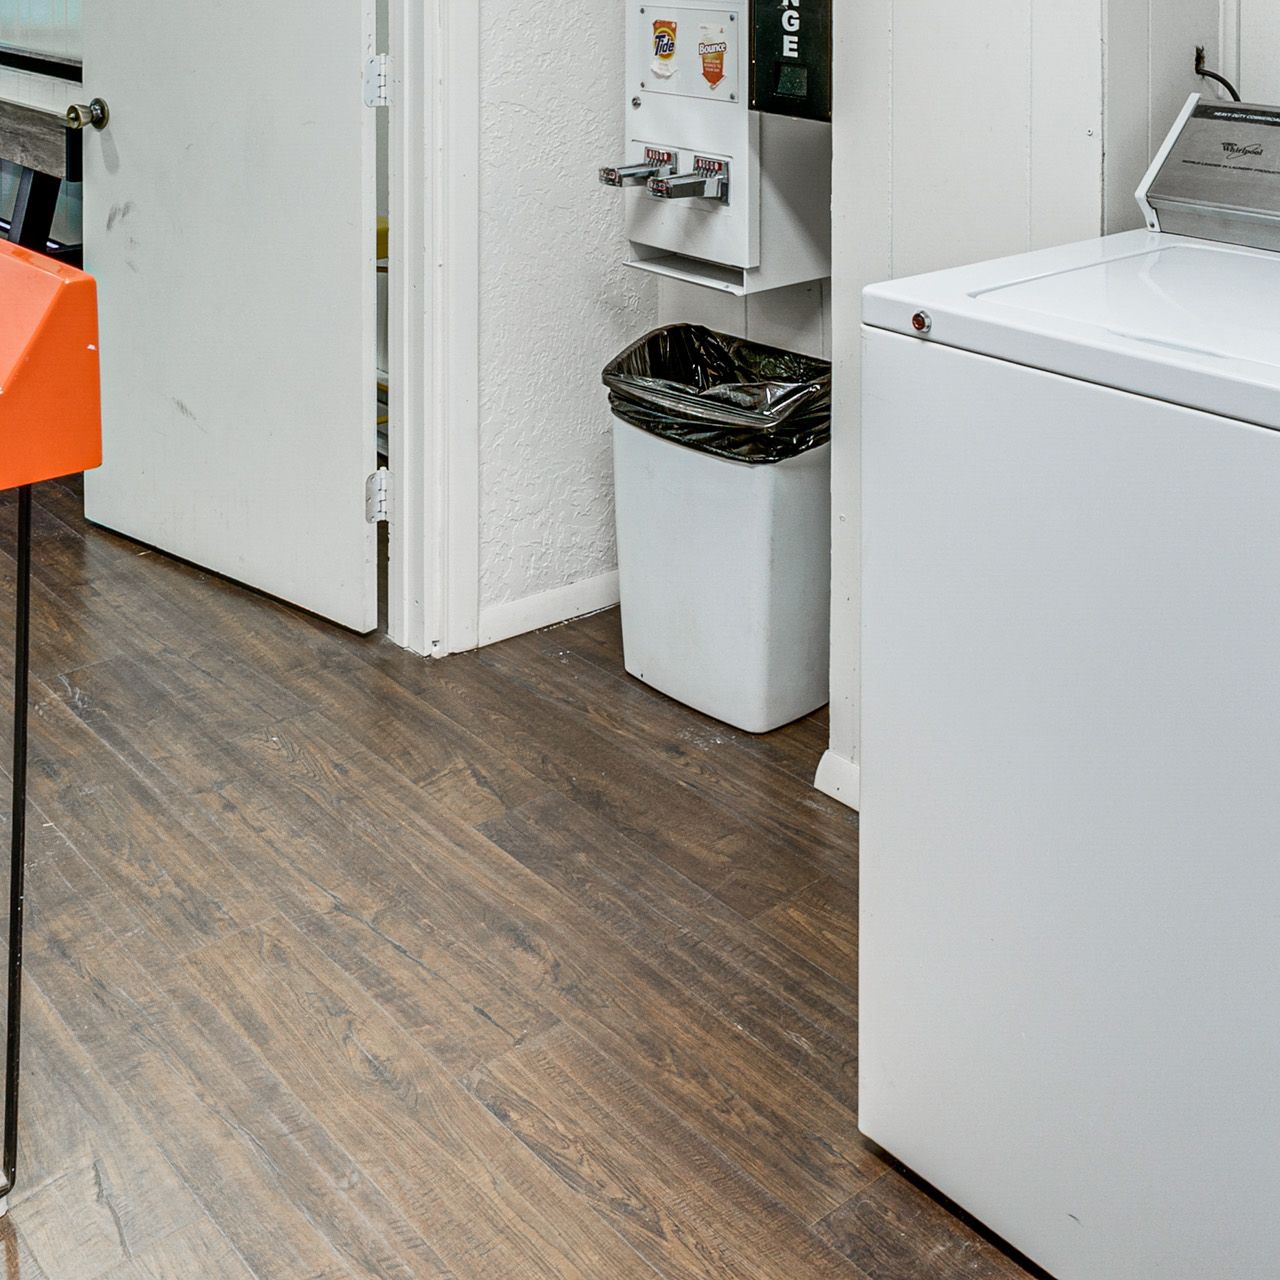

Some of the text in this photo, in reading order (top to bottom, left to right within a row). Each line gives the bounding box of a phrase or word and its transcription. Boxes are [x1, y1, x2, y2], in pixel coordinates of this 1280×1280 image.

[655, 35, 675, 56] Tide
[699, 42, 727, 55] Bounce
[1222, 144, 1264, 157] Whirlpool
